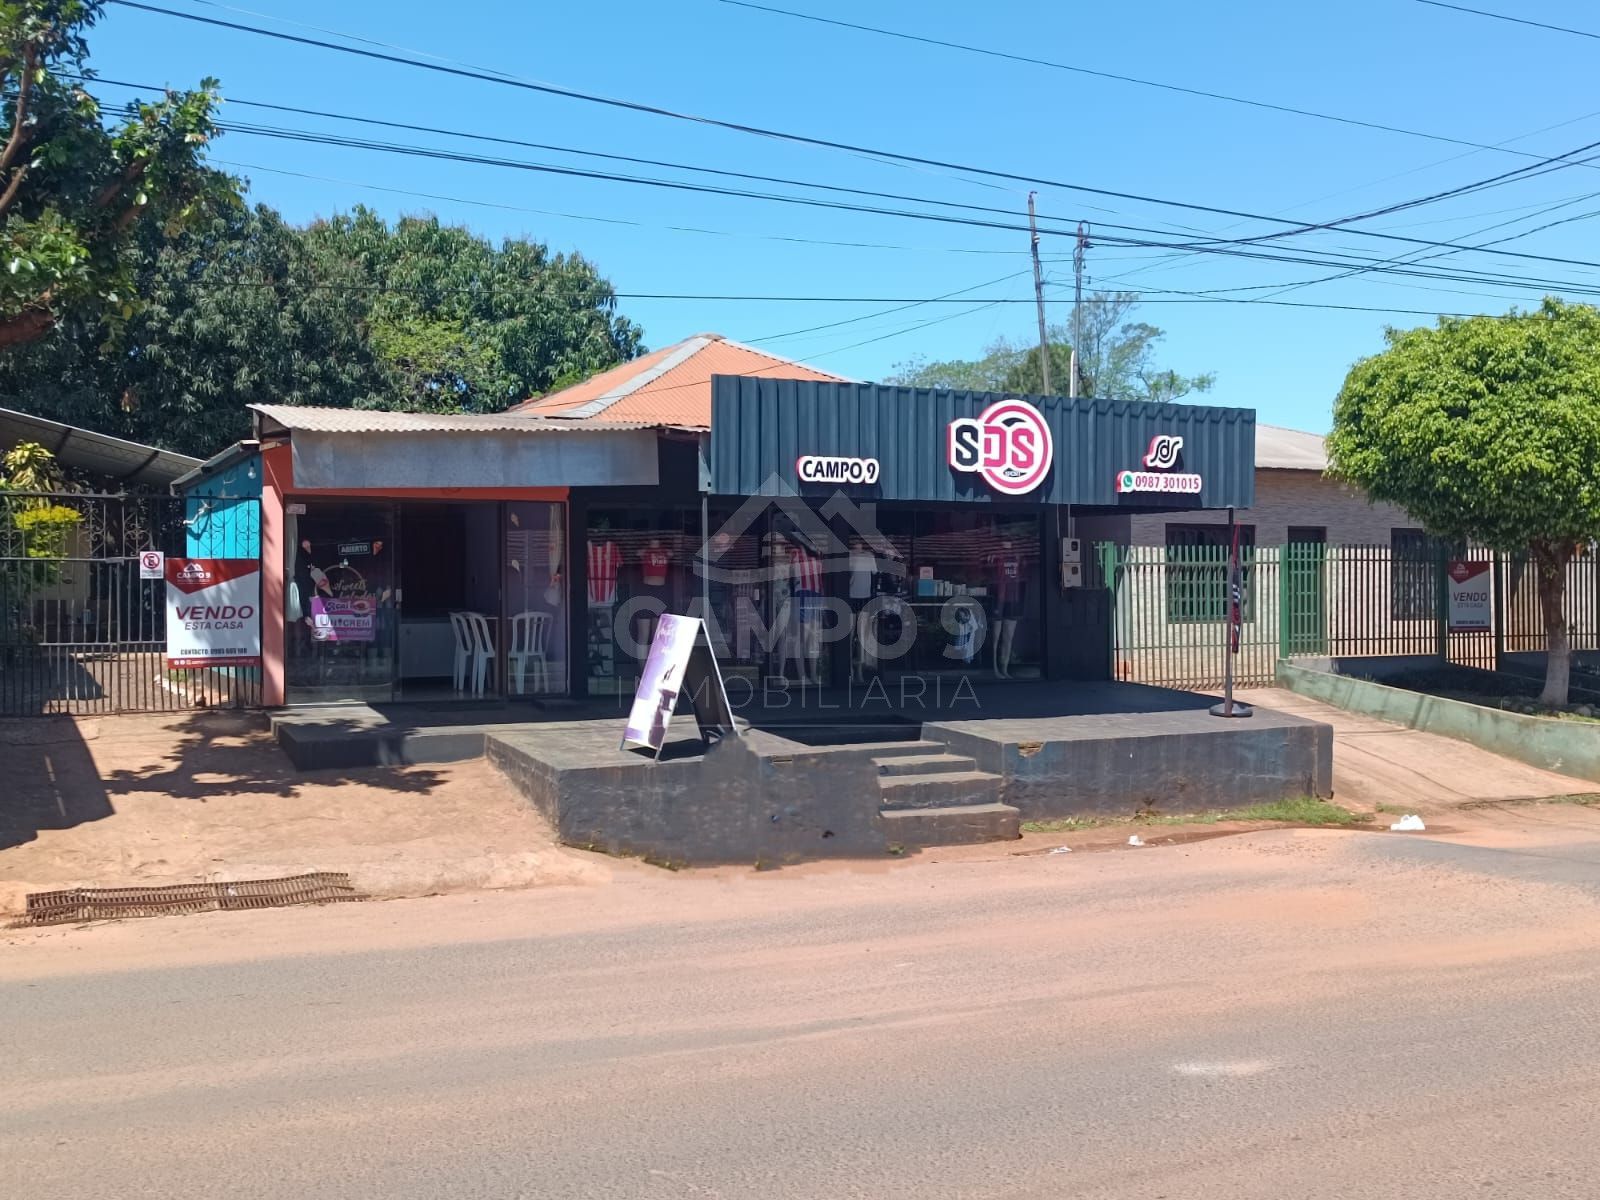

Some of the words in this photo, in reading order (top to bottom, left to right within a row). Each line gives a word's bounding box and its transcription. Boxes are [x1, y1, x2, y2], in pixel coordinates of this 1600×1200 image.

[955, 424, 1034, 468] SDS
[802, 460, 862, 479] CAMPO
[867, 465, 876, 480] 9
[1135, 475, 1160, 488] 0987
[1162, 476, 1199, 490] 301015
[341, 545, 368, 553] ABIERTO
[1453, 592, 1488, 602] VENDO
[175, 605, 254, 620] VENDO
[184, 621, 212, 631] ESTA
[214, 621, 244, 630] CASA
